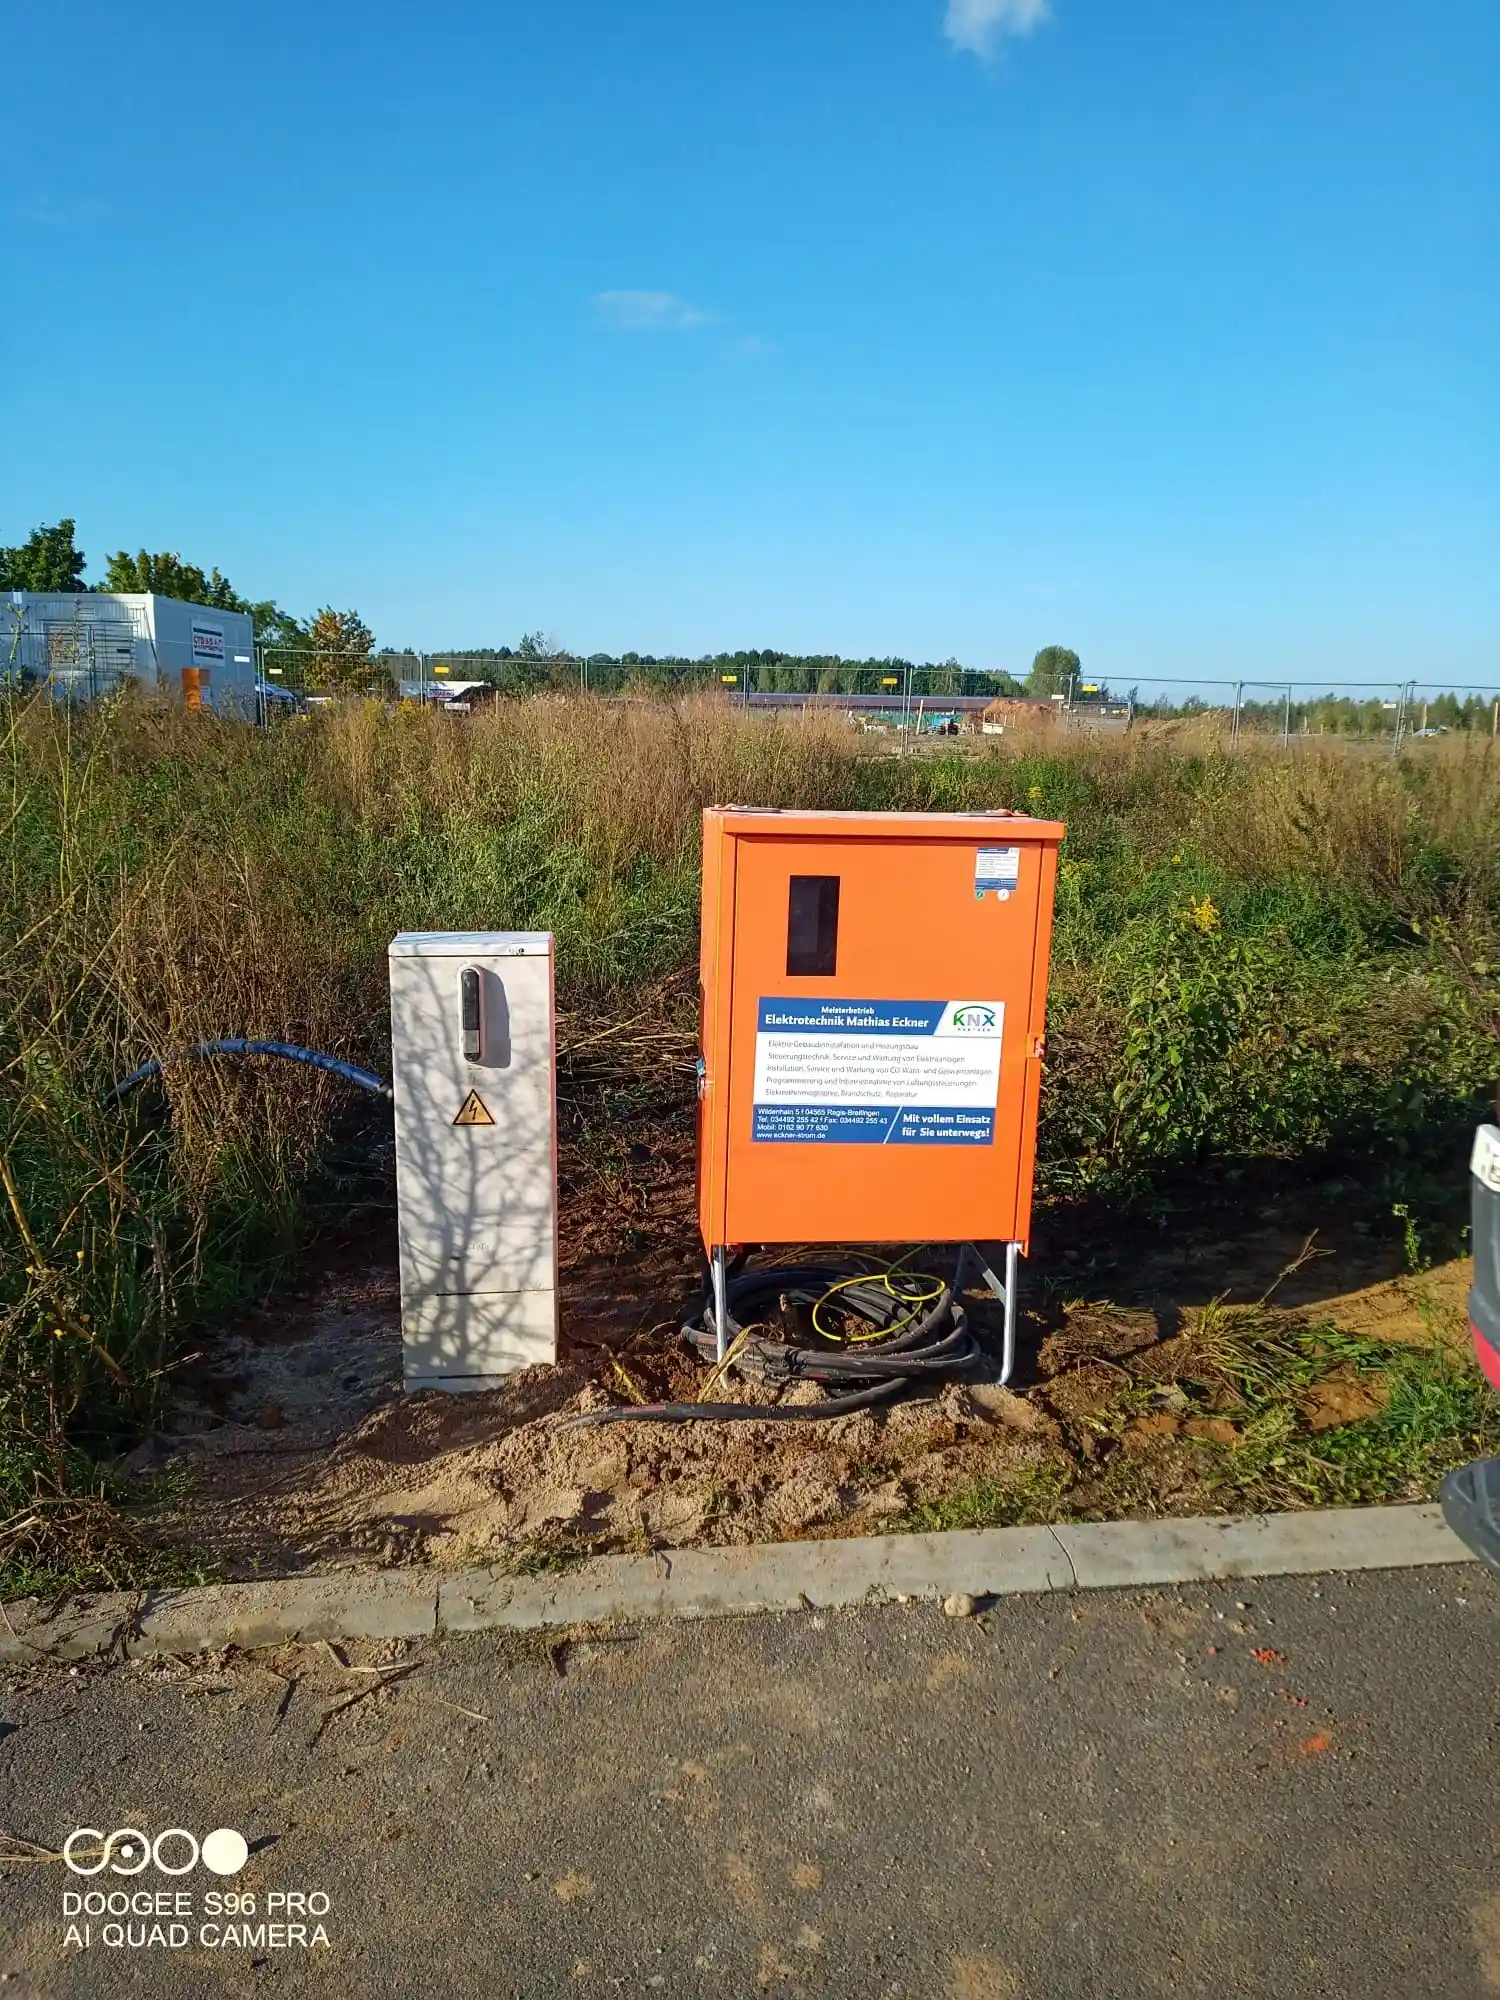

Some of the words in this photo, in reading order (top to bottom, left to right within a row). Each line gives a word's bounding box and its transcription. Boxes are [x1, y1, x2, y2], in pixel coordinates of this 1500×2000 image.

[821, 1006, 875, 1014] Meisterbetrieb
[765, 1014, 844, 1026] Elektrotechnik
[846, 1015, 890, 1027] Mathias
[892, 1017, 929, 1028] Eckner
[953, 1014, 996, 1027] KNX
[876, 1043, 919, 1051] Heizungsbau
[833, 1053, 857, 1061] Service
[872, 1055, 901, 1063] Wartung
[916, 1055, 965, 1064] Elektroanlagen
[806, 1065, 830, 1073] Service
[831, 1065, 845, 1073] und
[846, 1066, 875, 1074] Wartung
[766, 1076, 823, 1086] Programmierung
[824, 1077, 838, 1085] und
[885, 1090, 918, 1098] Reparatur
[903, 1114, 921, 1123] Mit
[921, 1114, 954, 1124] vollem
[956, 1115, 991, 1124] Einsatz
[902, 1127, 916, 1137] für
[919, 1128, 935, 1137] Sie
[936, 1128, 990, 1139] unterwegs!
